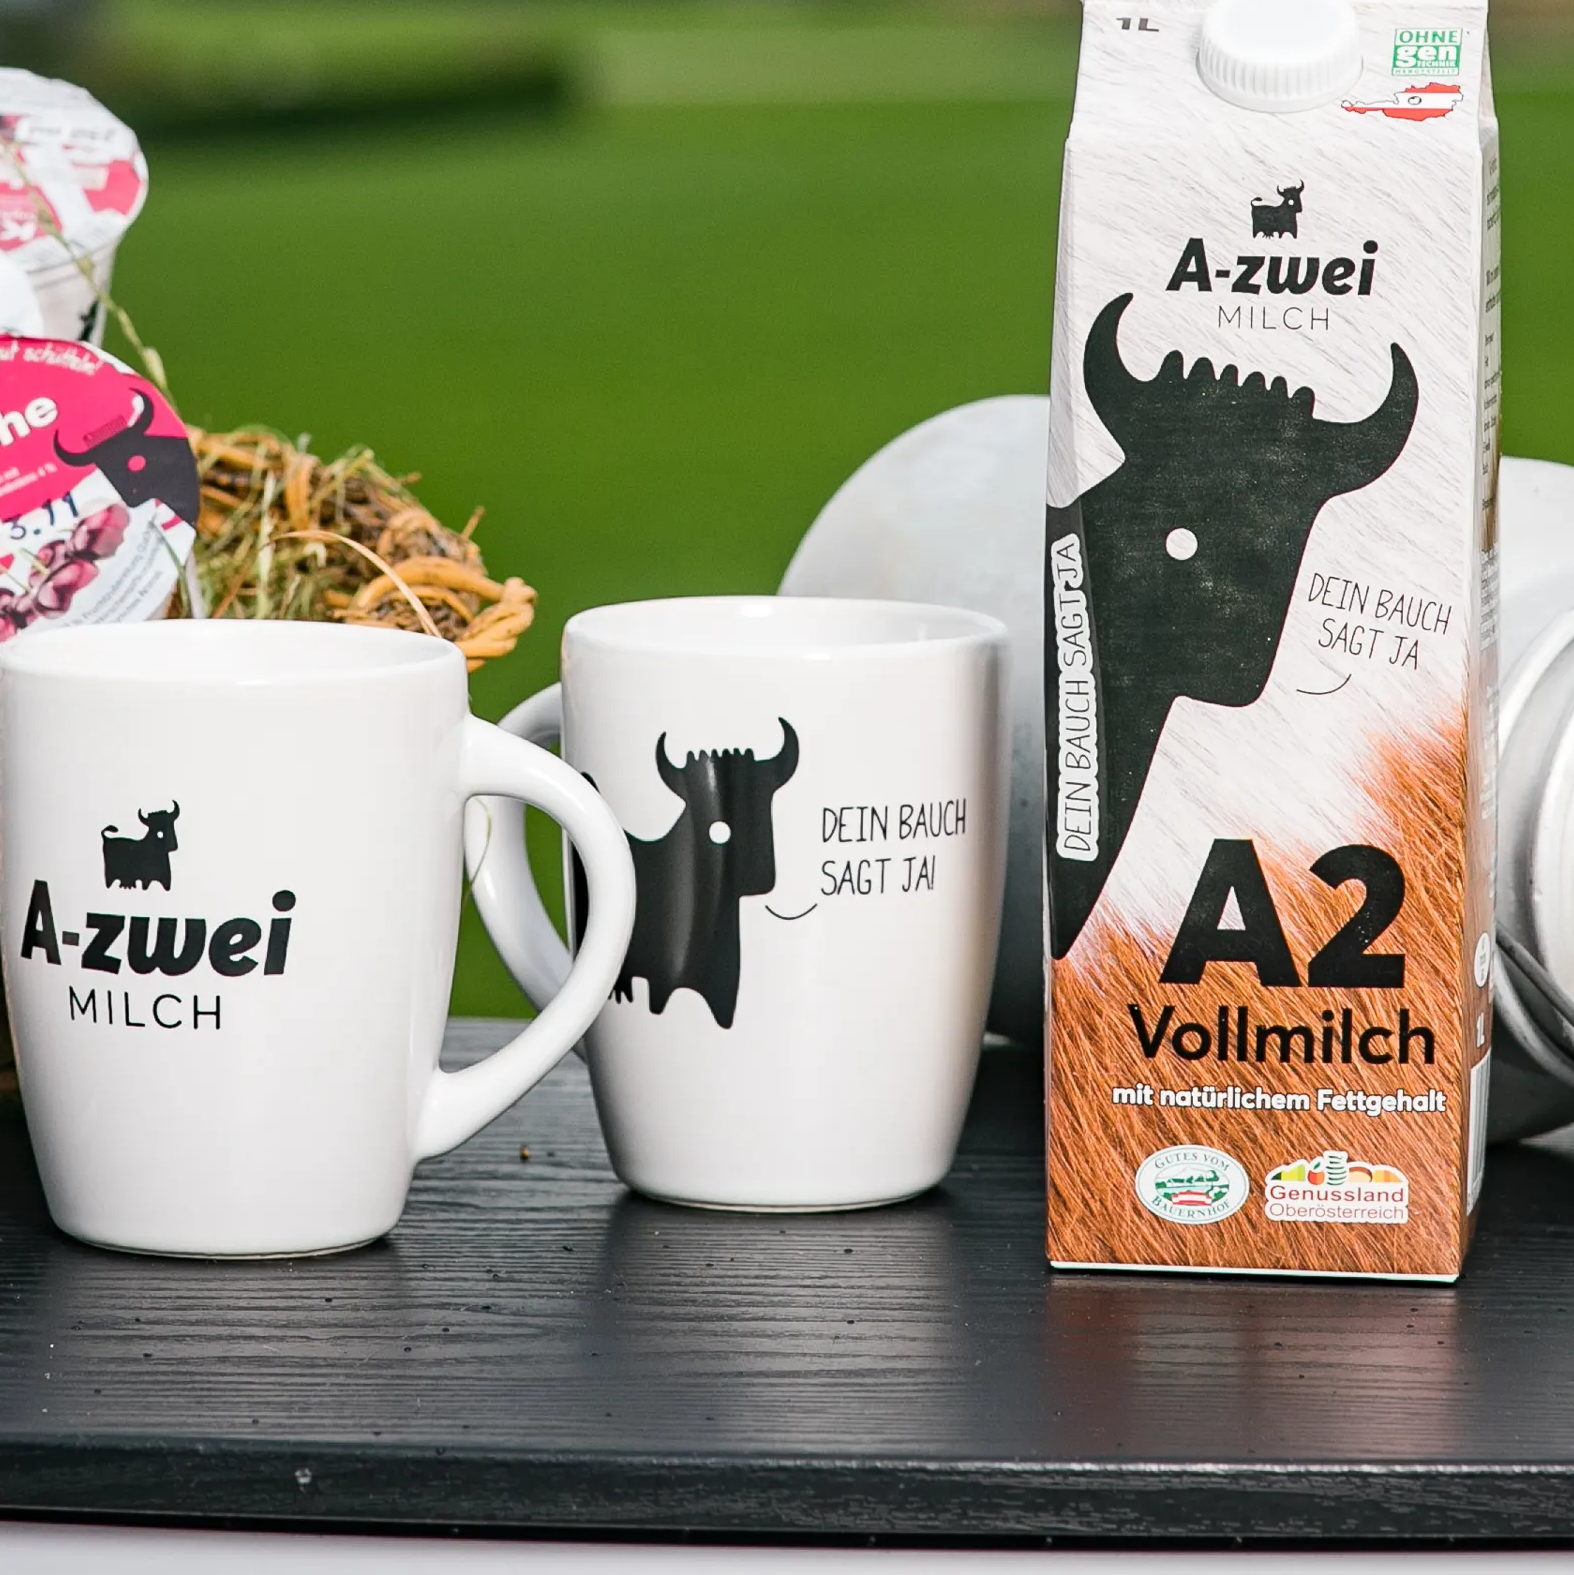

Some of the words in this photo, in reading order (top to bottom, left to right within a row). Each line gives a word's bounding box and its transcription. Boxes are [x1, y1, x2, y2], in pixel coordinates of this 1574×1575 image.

[1115, 17, 1160, 33] 1L
[1398, 30, 1459, 44] OHNE
[1395, 45, 1457, 69] gen
[1415, 60, 1457, 68] TECHNIK
[1165, 237, 1378, 296] A-zwei
[1218, 306, 1329, 331] MILCH
[1055, 542, 1078, 581] JA
[1308, 573, 1368, 620] DEIN
[1375, 589, 1452, 636] BAUCH
[1058, 592, 1087, 667] SAGT
[1320, 618, 1381, 662] SAGT
[1388, 634, 1421, 671] JA
[1064, 679, 1092, 771] BAUCH
[822, 805, 888, 843] DEIN
[898, 798, 967, 839] BAUCH
[1063, 780, 1093, 853] DEIN
[821, 859, 890, 896] SAGT
[901, 855, 936, 893] JA!
[20, 879, 297, 977] A-zwei
[1160, 838, 1405, 989] A2
[69, 986, 221, 1030] MILCH
[1127, 1004, 1436, 1066] Vollmilch
[1112, 1084, 1154, 1107] mit
[1160, 1086, 1310, 1112] natürlichem
[1316, 1089, 1447, 1114] Fettgehalt
[1154, 1152, 1199, 1170] GUTES
[1150, 1195, 1232, 1220] BAUERNHOF
[1269, 1202, 1404, 1220] Oberösterreich
[1270, 1185, 1404, 1203] Genussland
